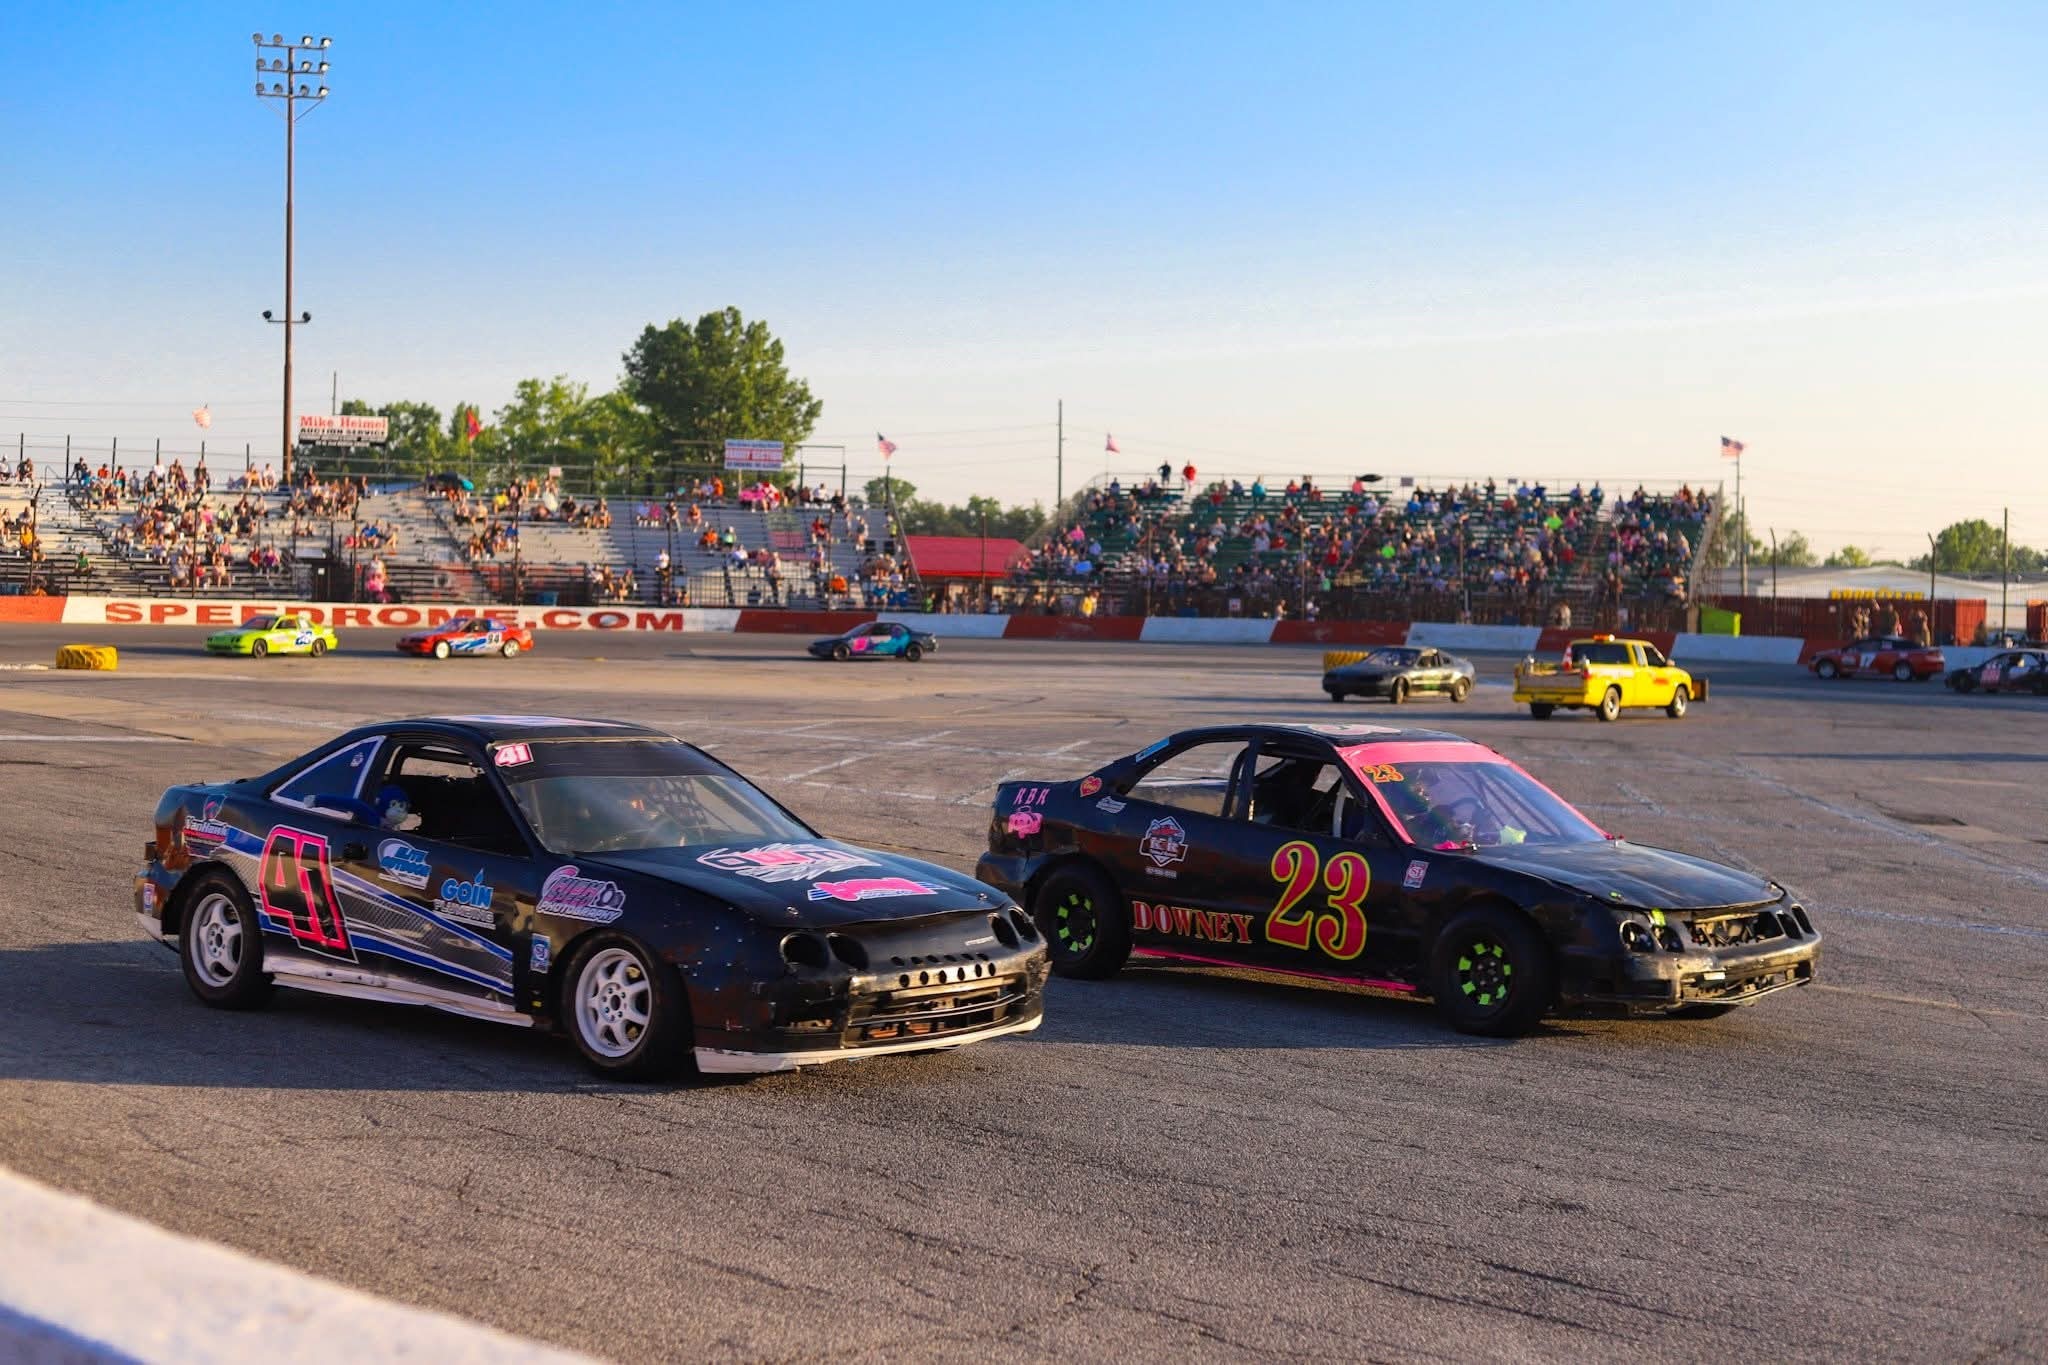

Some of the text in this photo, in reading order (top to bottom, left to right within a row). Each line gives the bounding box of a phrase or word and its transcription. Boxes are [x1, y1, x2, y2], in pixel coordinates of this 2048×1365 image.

[301, 416, 334, 427] Mike
[497, 744, 531, 766] 41
[1363, 764, 1404, 783] 23
[259, 826, 350, 952] 41
[441, 877, 494, 910] GOIN
[1266, 840, 1371, 960] 23
[433, 899, 495, 923] PLUMBING
[540, 901, 618, 921] PHOTOGRAPHY
[1132, 901, 1254, 945] DOWNEY
